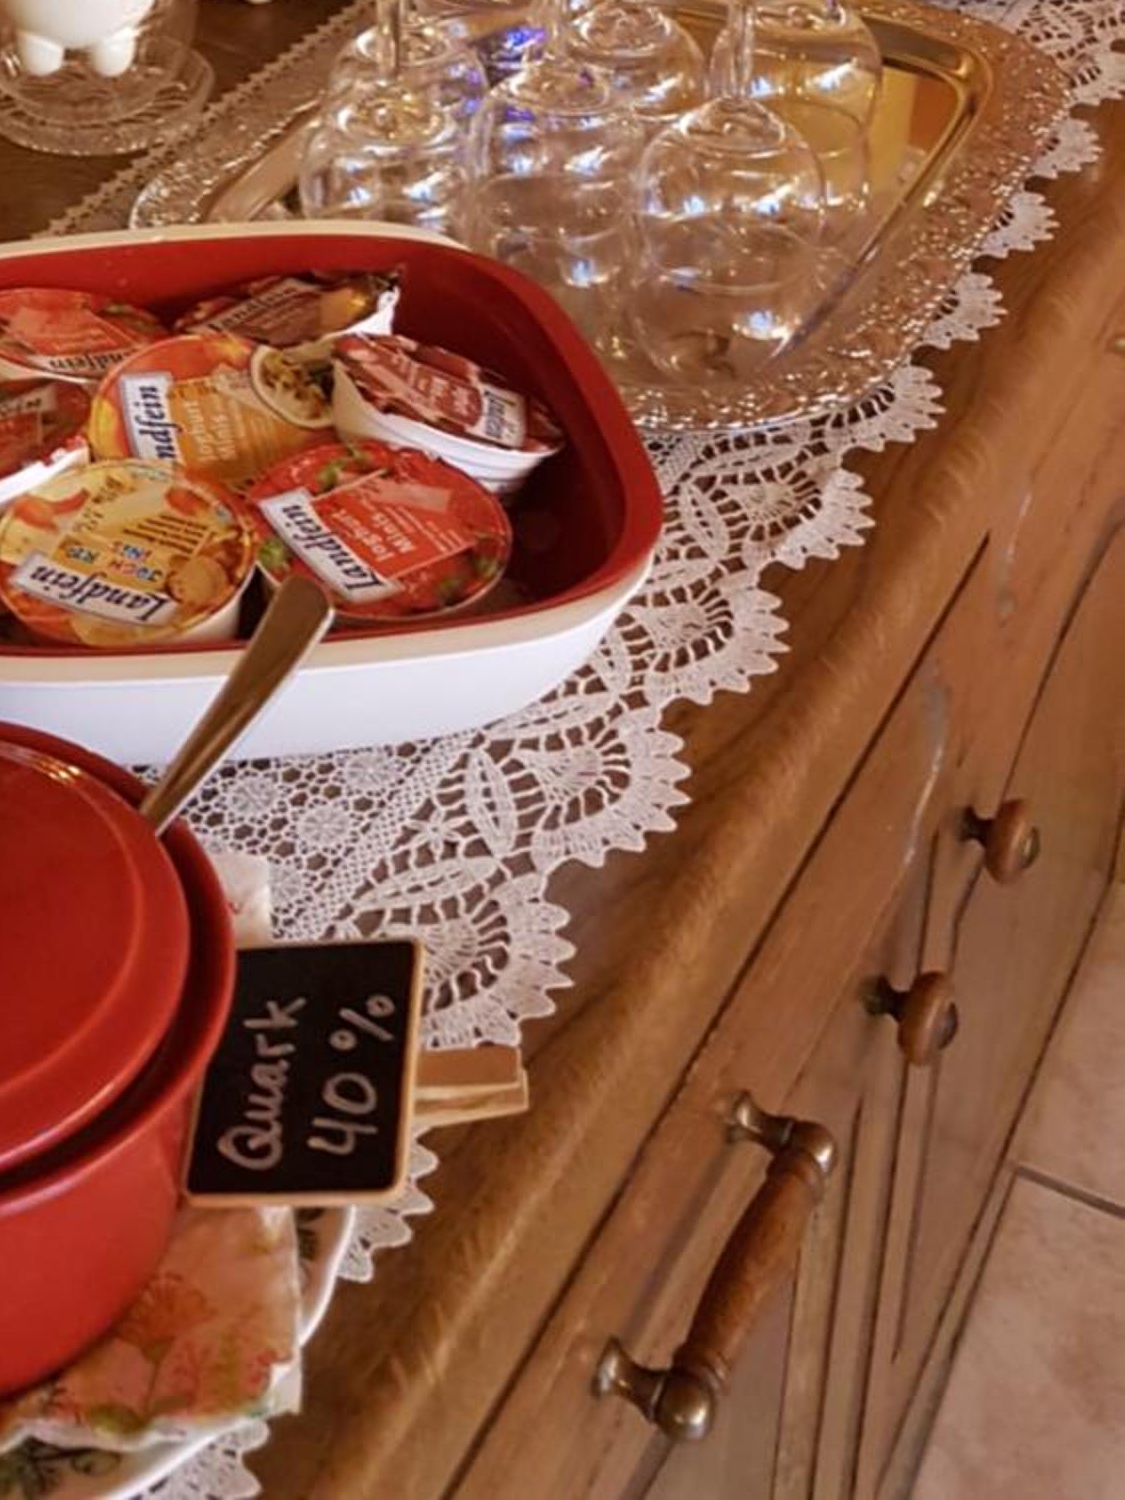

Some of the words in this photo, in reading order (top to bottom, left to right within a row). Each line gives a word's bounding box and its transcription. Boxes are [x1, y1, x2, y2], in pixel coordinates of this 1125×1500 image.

[134, 385, 184, 460] ndfein
[281, 503, 384, 591] Landfein
[29, 565, 168, 622] Landfein
[328, 994, 397, 1051] %
[217, 997, 308, 1171] Quark
[306, 1072, 379, 1156] 40
